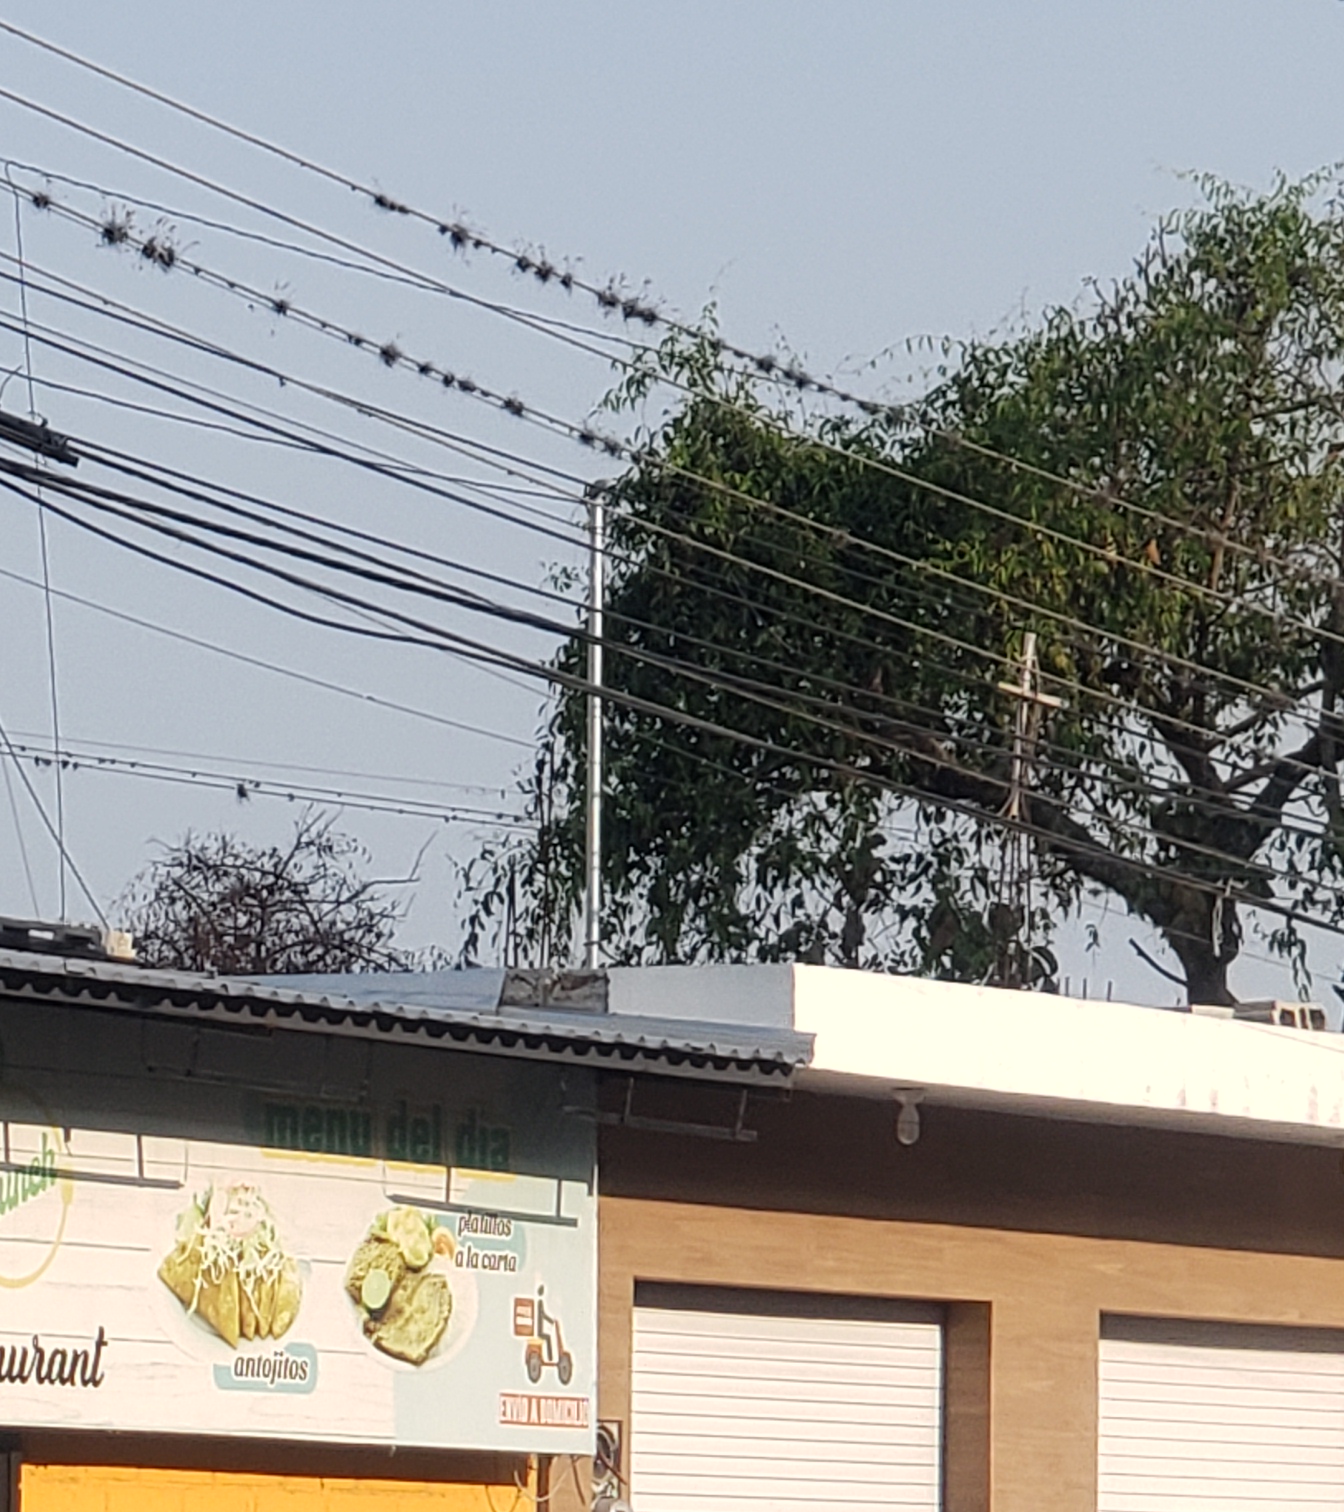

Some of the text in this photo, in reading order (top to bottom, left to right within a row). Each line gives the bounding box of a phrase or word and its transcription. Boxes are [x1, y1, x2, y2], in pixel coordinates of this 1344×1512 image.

[455, 1244, 517, 1272] a la carta
[234, 1350, 309, 1385] antojitos
